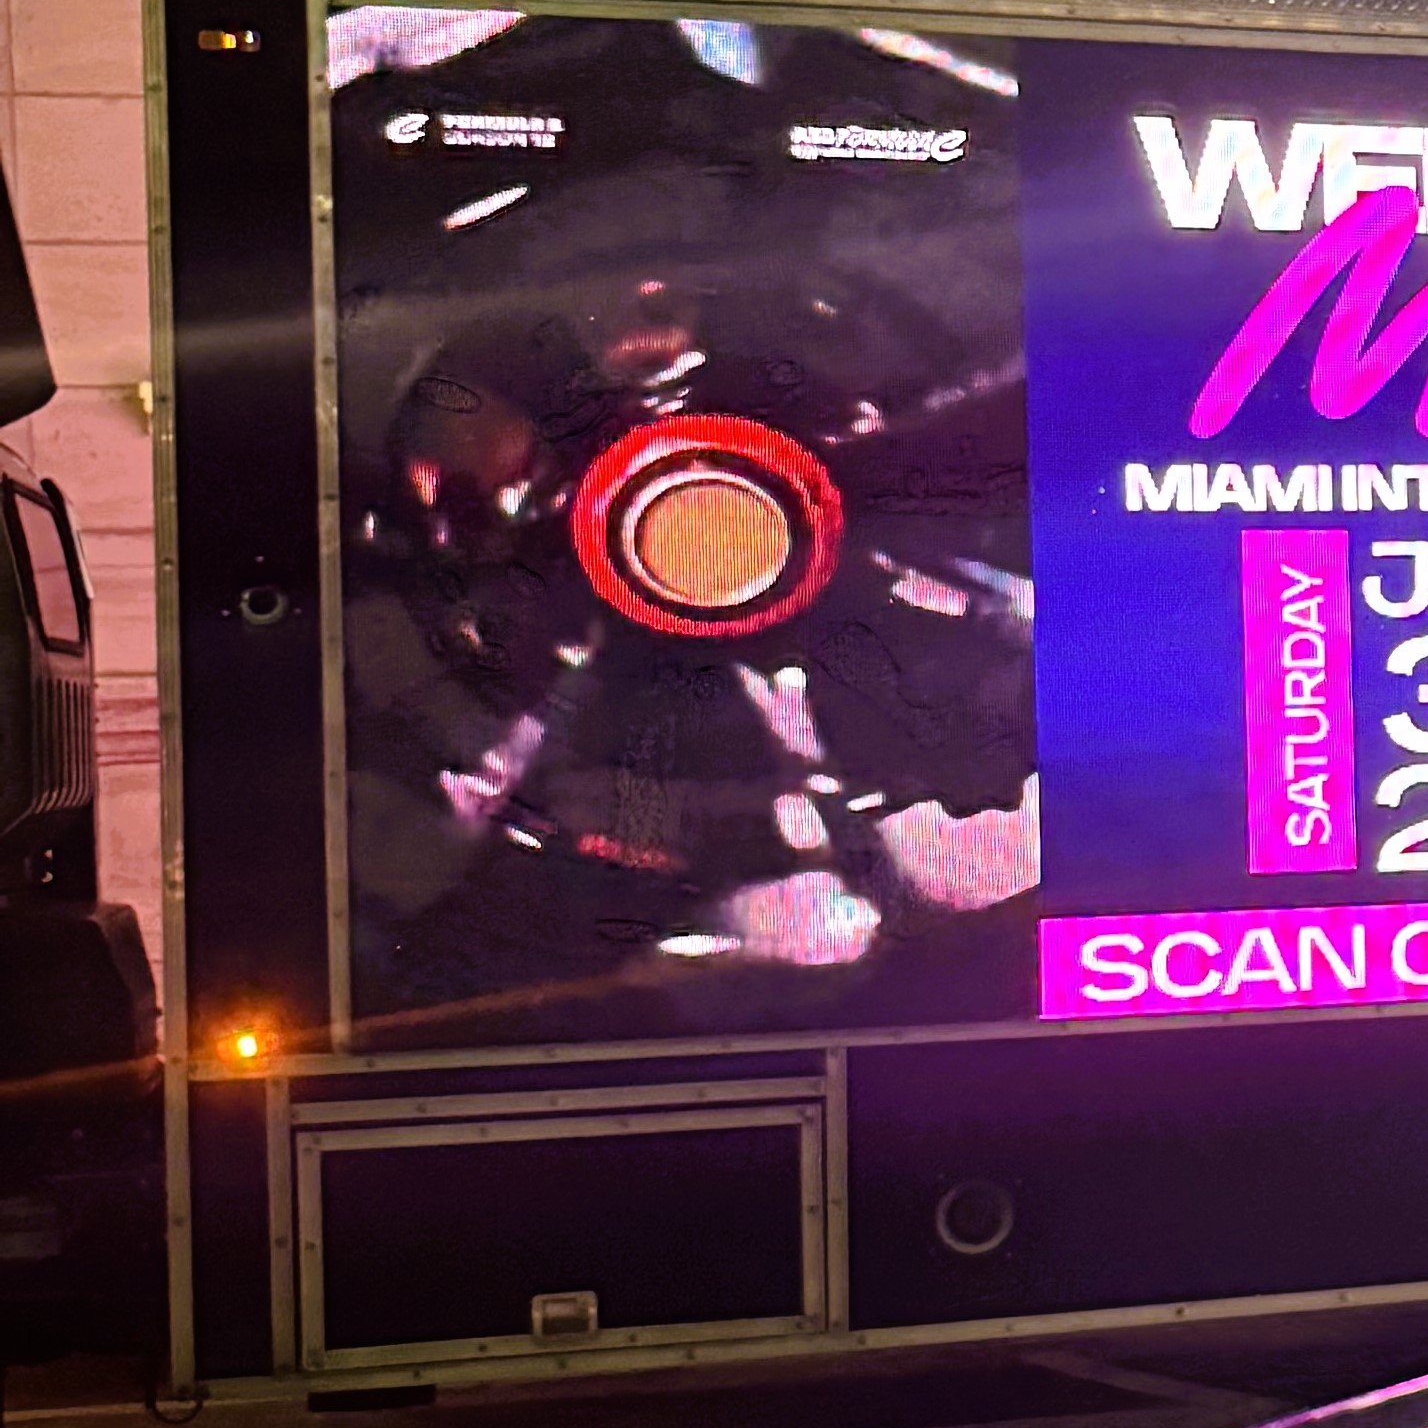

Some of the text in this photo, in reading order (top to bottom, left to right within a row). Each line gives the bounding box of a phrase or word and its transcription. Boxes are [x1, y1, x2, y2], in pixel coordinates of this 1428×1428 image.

[1124, 463, 1332, 512] MIAMI
[1280, 562, 1332, 847] SATURDAY
[1079, 923, 1367, 1002] SCAN
